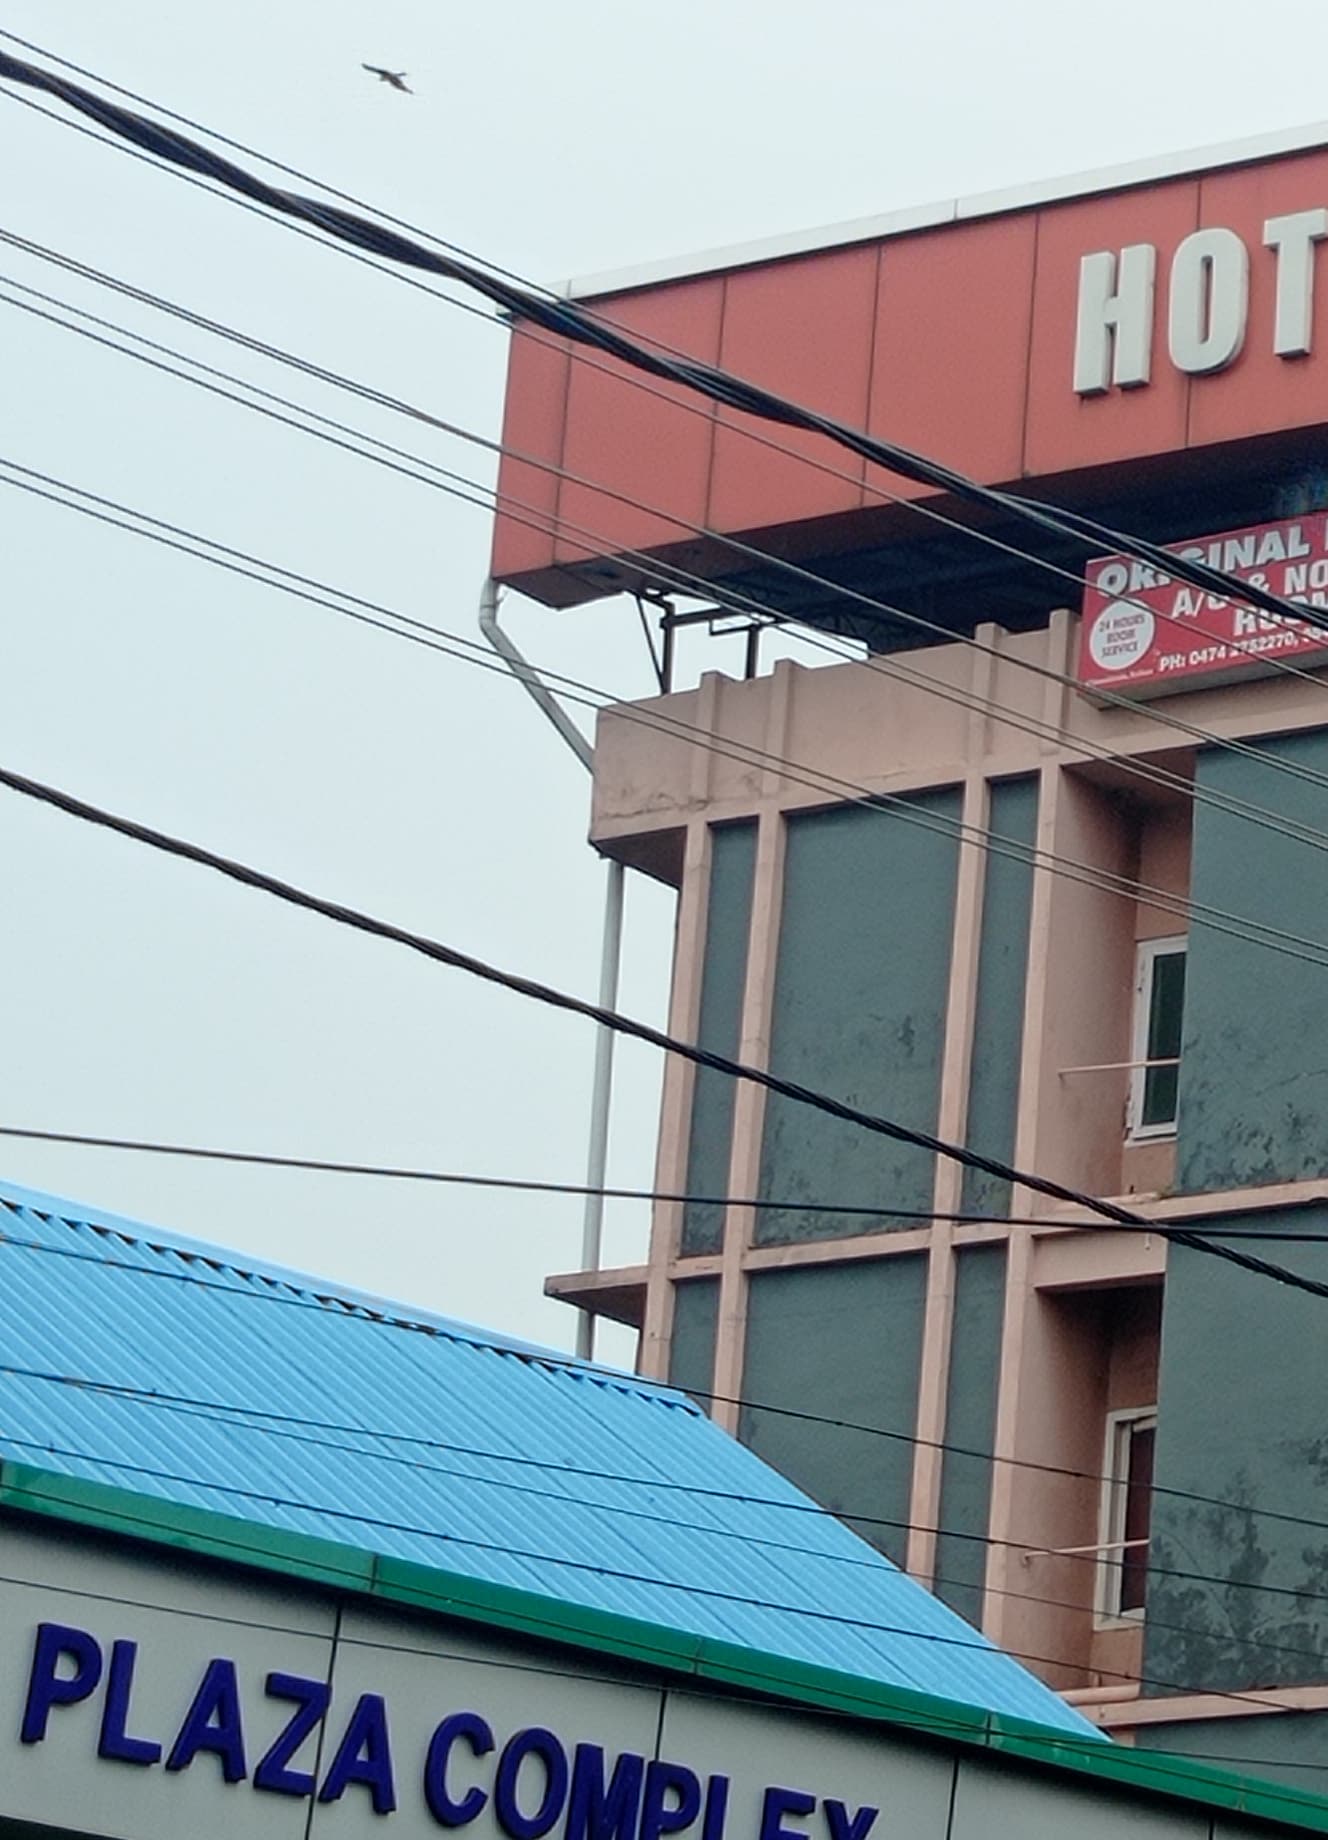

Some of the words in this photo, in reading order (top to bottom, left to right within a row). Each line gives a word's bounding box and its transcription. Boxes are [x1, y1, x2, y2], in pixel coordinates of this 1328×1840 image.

[1097, 525, 1310, 597] ORINAL
[1189, 645, 1226, 666] 0474
[20, 1622, 398, 1816] PLAZA
